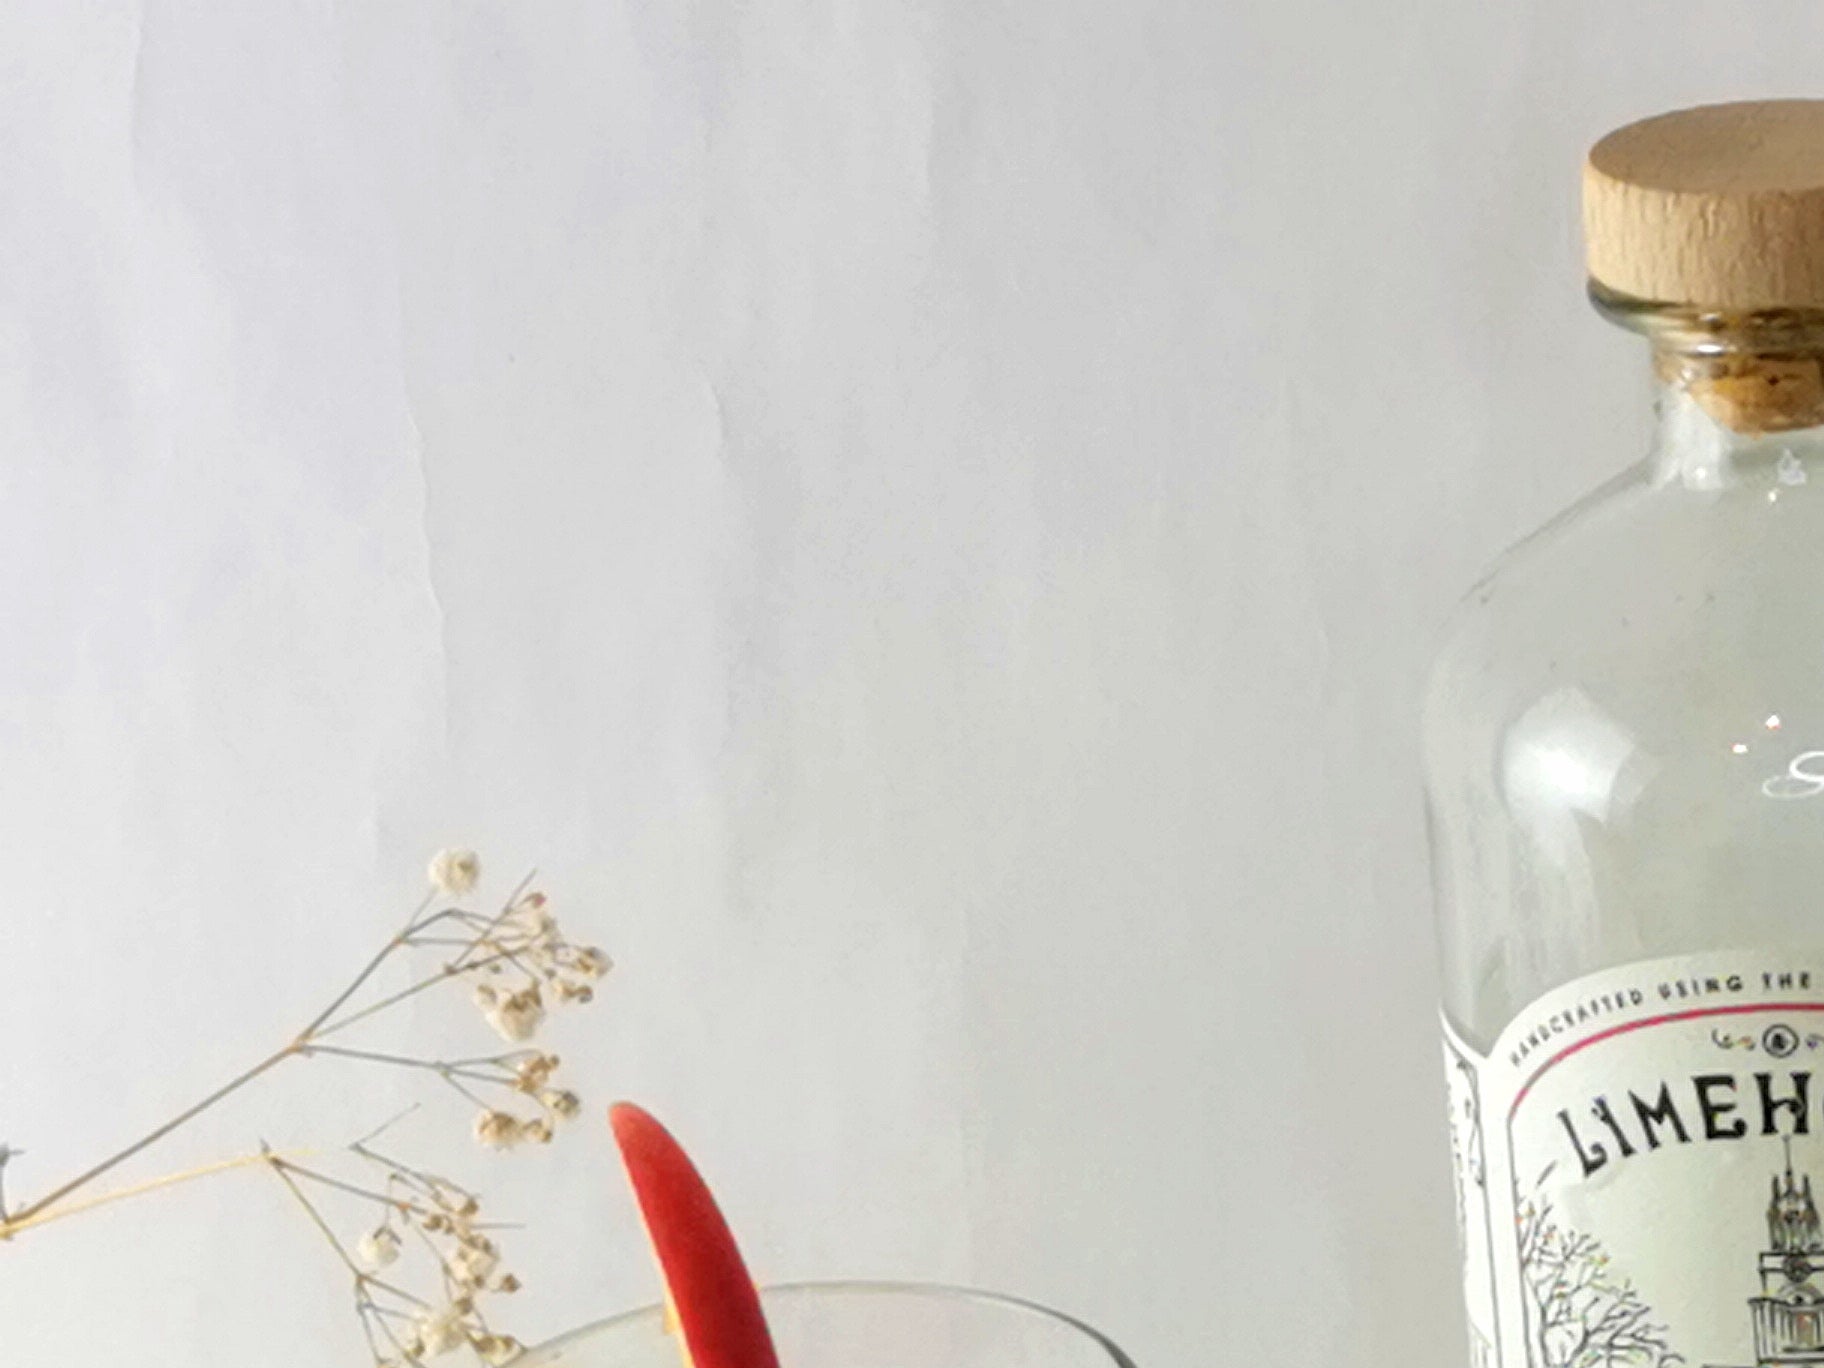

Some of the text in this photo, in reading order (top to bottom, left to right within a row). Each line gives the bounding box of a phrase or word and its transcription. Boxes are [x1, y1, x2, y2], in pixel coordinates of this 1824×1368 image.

[1510, 989, 1643, 1067] HANDCRAFTED
[1658, 975, 1743, 1000] USING
[1761, 972, 1810, 990] THE
